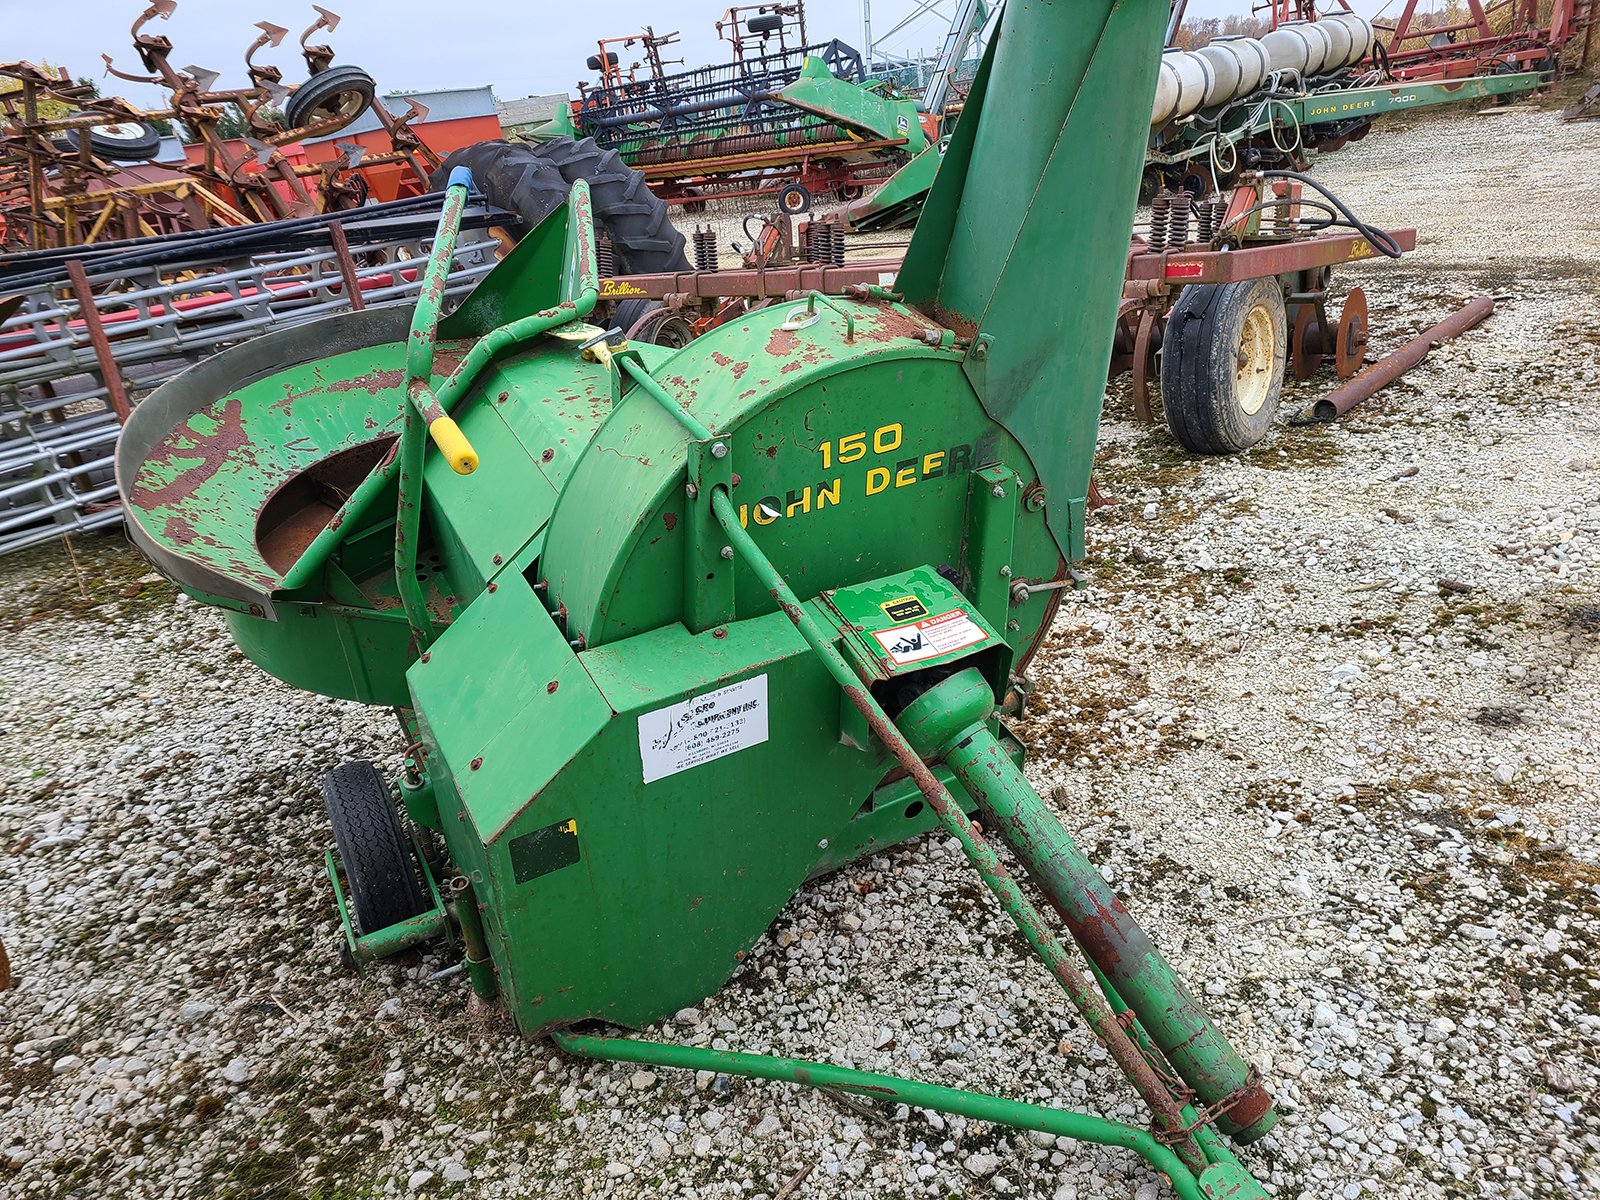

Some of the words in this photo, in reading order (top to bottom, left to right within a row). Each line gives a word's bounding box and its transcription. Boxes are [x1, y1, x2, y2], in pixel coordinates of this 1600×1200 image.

[1388, 94, 1416, 104] 7000
[1310, 106, 1337, 115] JOHN
[1342, 100, 1376, 111] DEERE
[600, 280, 647, 296] Brillion
[818, 422, 903, 470] 150
[739, 478, 841, 530] JOHN
[865, 432, 998, 496] DEERE
[930, 610, 962, 624] DANGER
